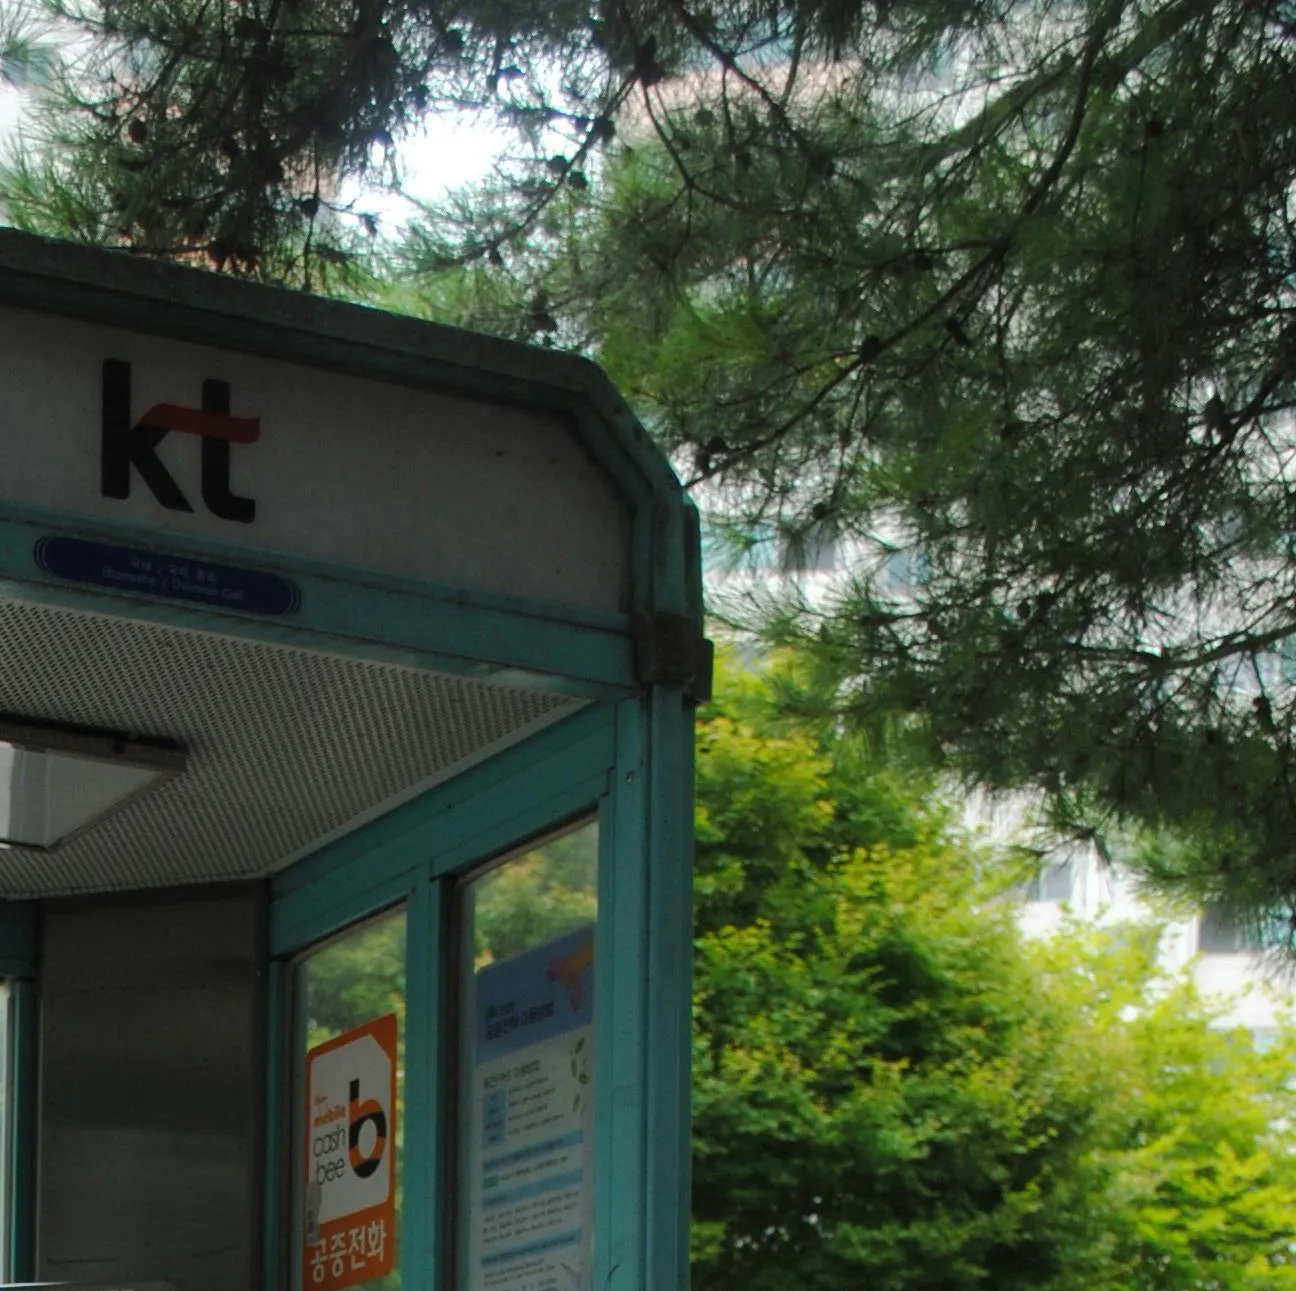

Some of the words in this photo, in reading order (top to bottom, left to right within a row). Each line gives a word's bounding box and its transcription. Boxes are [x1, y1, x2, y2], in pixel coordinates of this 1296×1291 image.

[101, 358, 260, 524] kt
[313, 1123, 346, 1158] cash
[316, 1157, 346, 1186] bee
[309, 1219, 387, 1284] 공중전화
